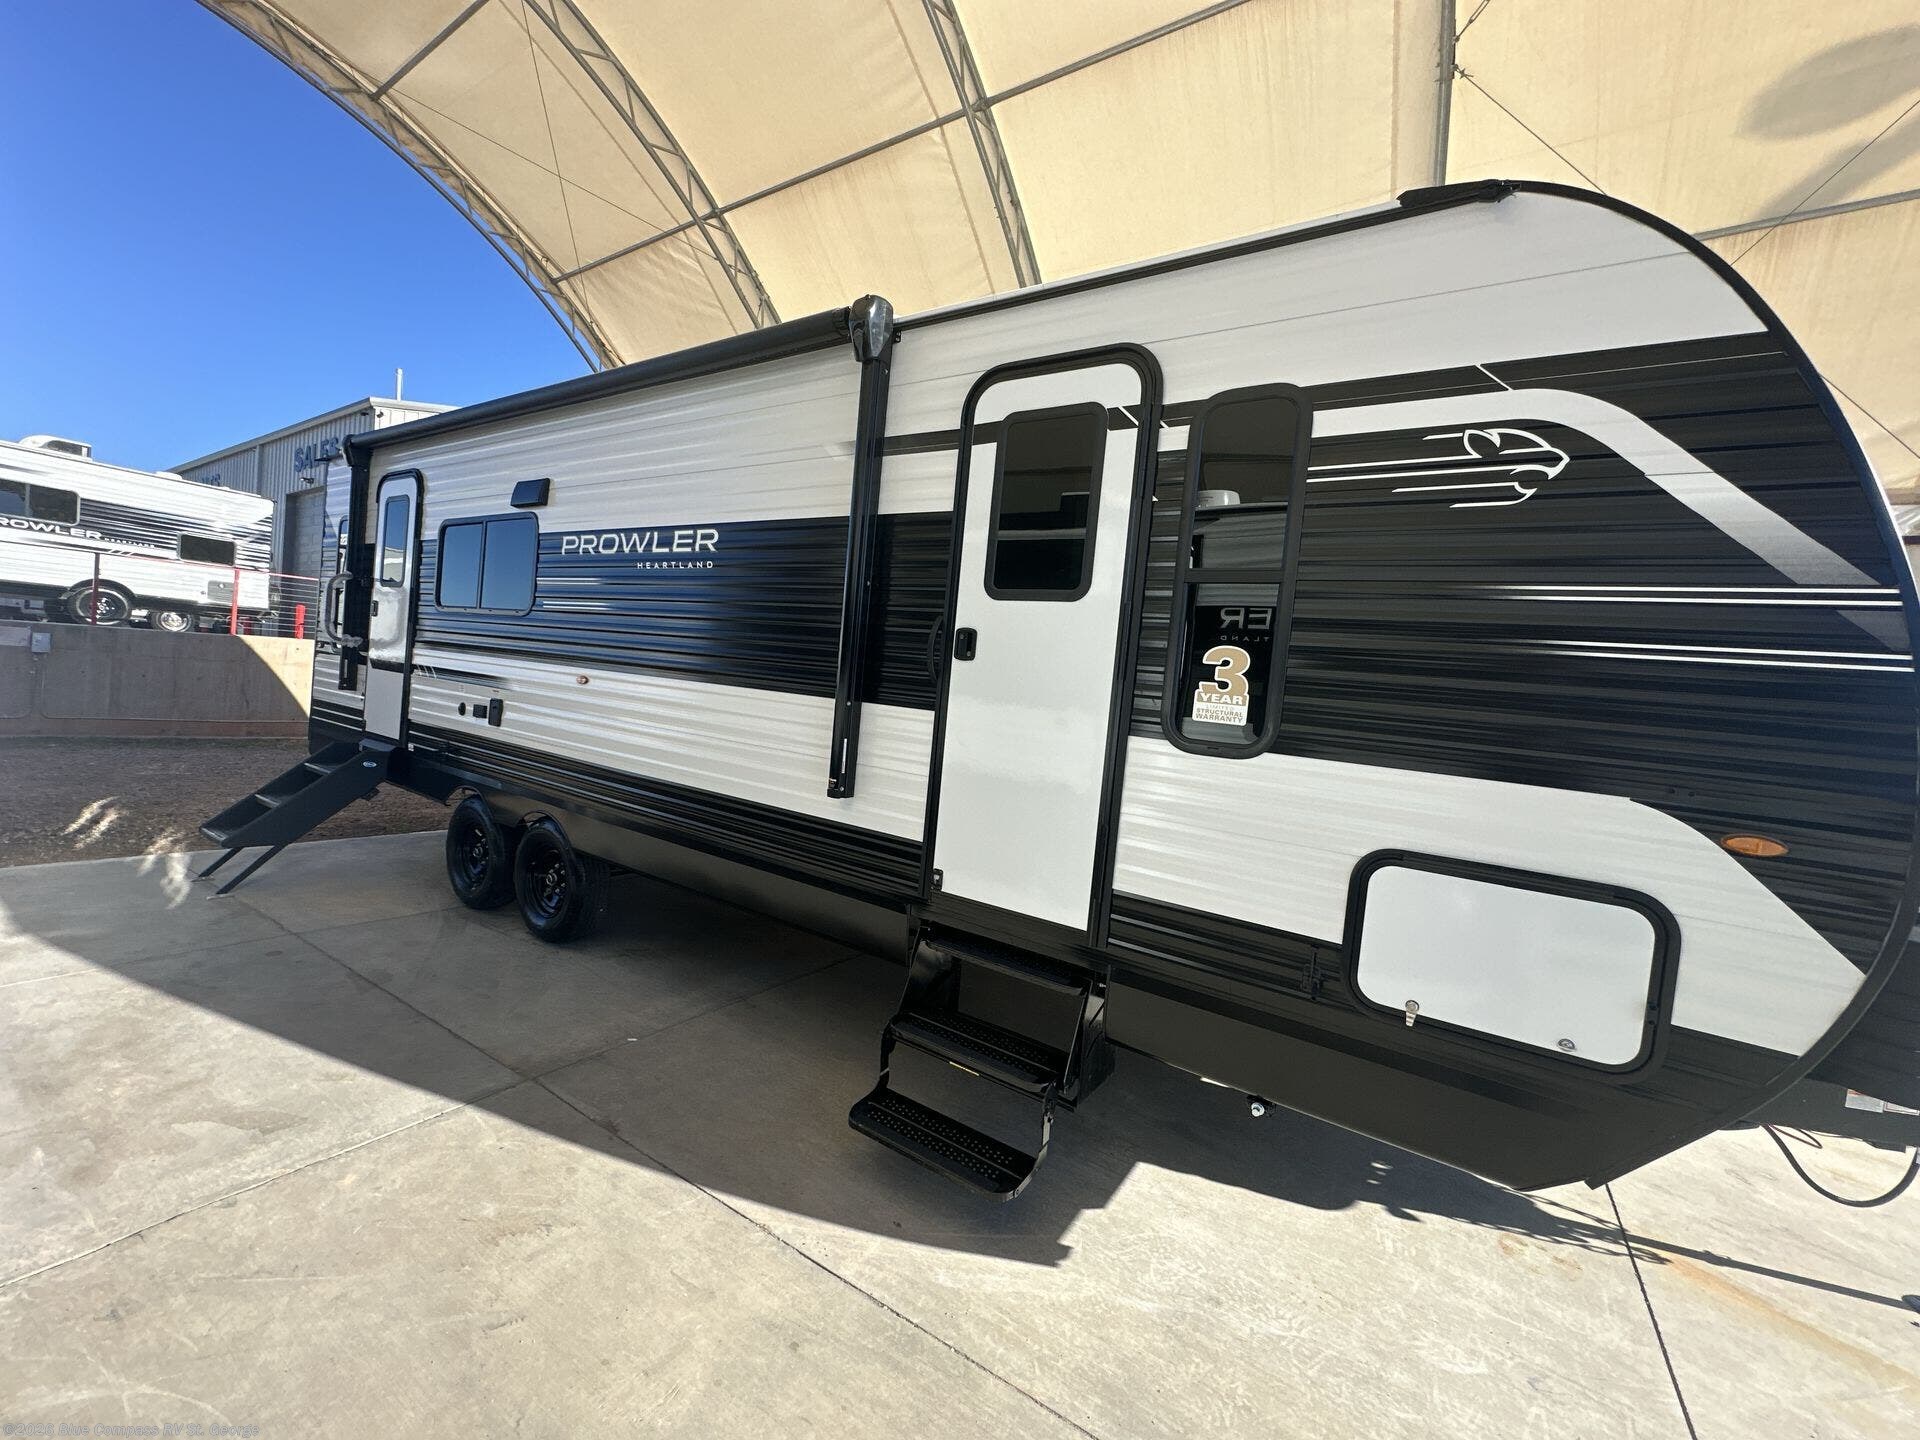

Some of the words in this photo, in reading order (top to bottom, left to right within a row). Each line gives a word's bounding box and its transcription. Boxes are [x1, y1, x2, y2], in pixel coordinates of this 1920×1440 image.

[294, 437, 339, 473] SALES
[561, 528, 719, 555] PROWLER
[637, 561, 714, 569] HEARTLAND
[1200, 646, 1250, 694] 3
[1201, 693, 1243, 705] YEAR
[1195, 713, 1244, 723] WARRANTY
[1196, 708, 1243, 717] STRUCTURAL
